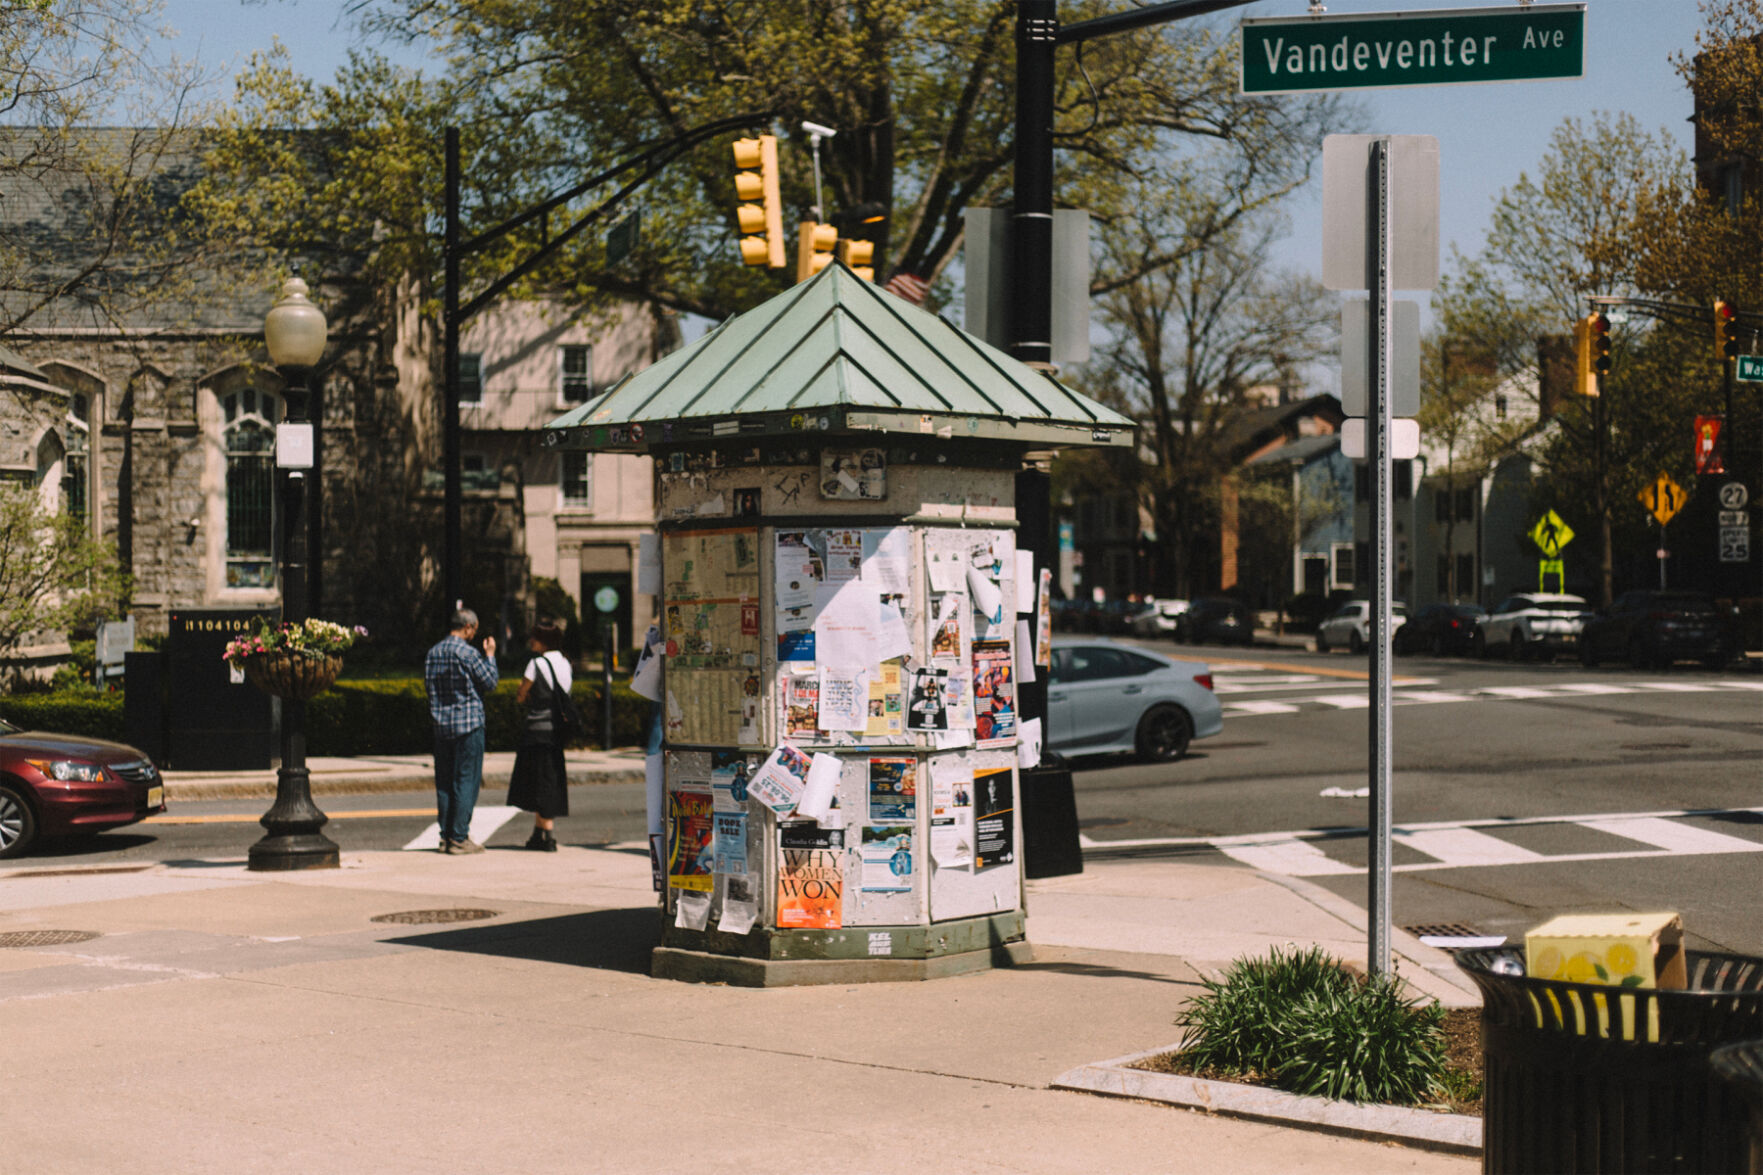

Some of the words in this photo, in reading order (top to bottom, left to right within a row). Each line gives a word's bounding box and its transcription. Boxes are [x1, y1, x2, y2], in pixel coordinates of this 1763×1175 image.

[1263, 31, 1497, 74] Vandeventer
[1523, 26, 1565, 49] Ave
[1723, 487, 1744, 505] 27
[1722, 543, 1748, 559] 25
[718, 818, 741, 827] BOOK
[720, 827, 740, 836] SALE
[782, 849, 844, 869] WHY
[780, 867, 844, 881] WOMEN
[781, 880, 842, 899] WON
